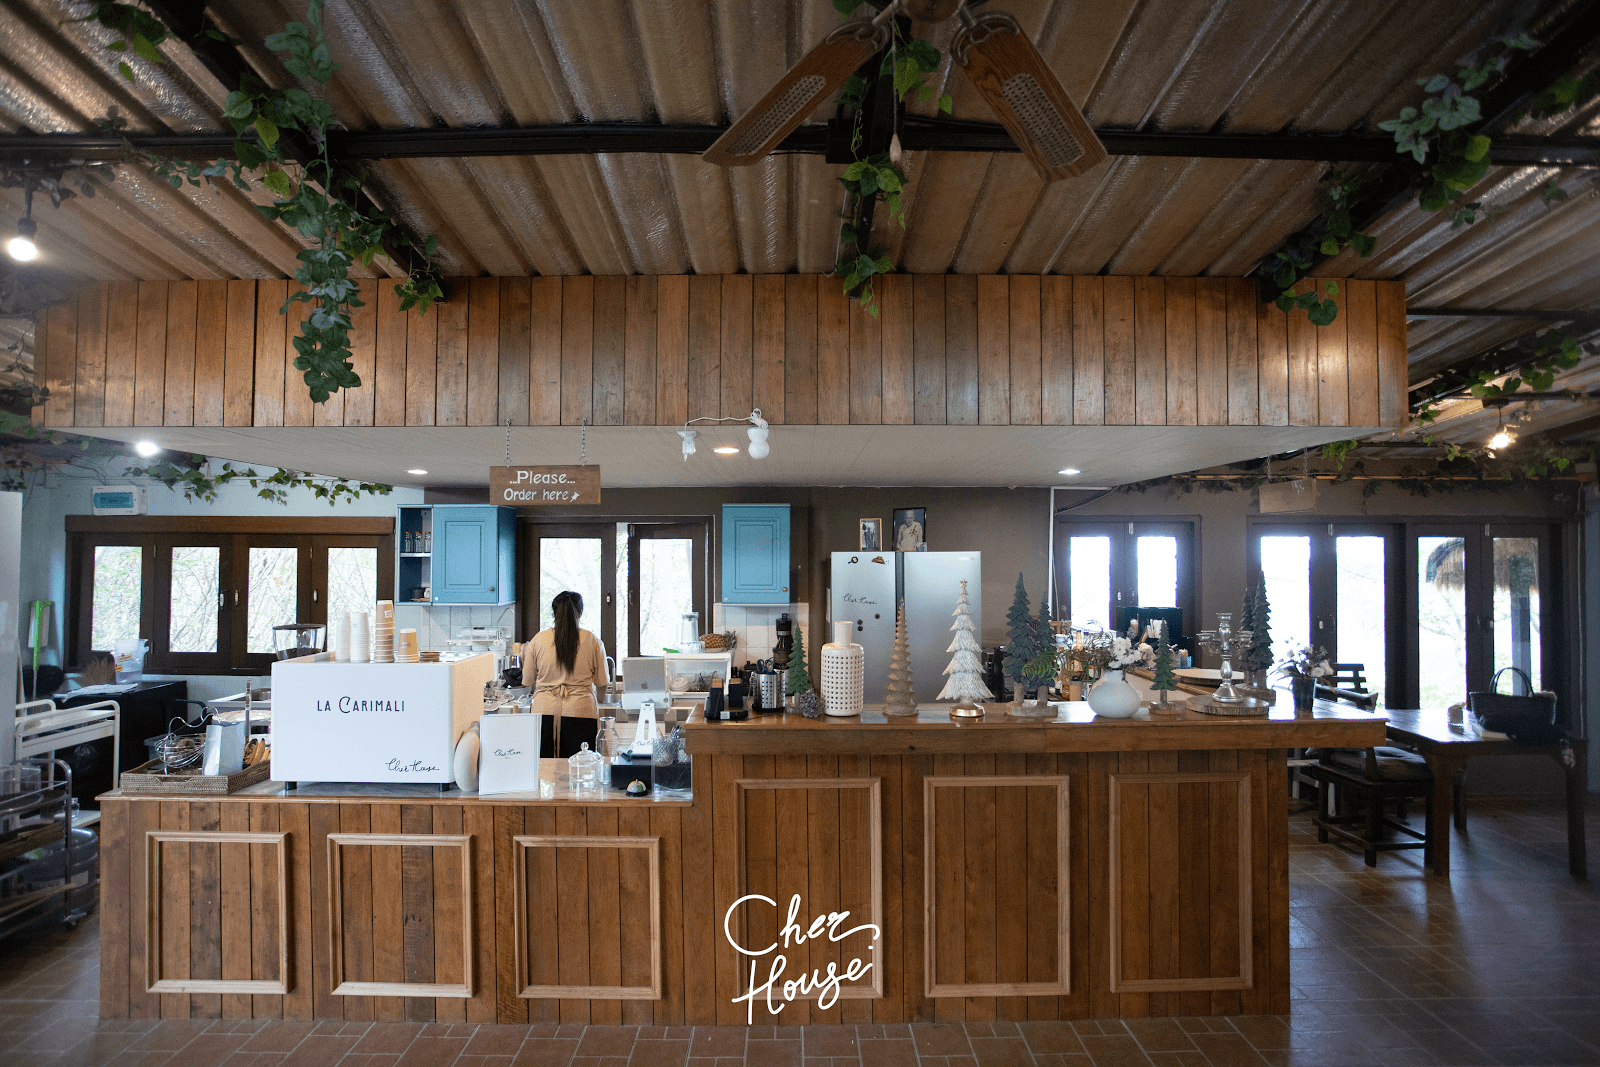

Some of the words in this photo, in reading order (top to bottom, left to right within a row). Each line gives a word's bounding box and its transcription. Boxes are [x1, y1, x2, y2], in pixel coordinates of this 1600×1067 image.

[503, 488, 537, 501] Order
[542, 488, 569, 501] here
[316, 700, 332, 712] LA
